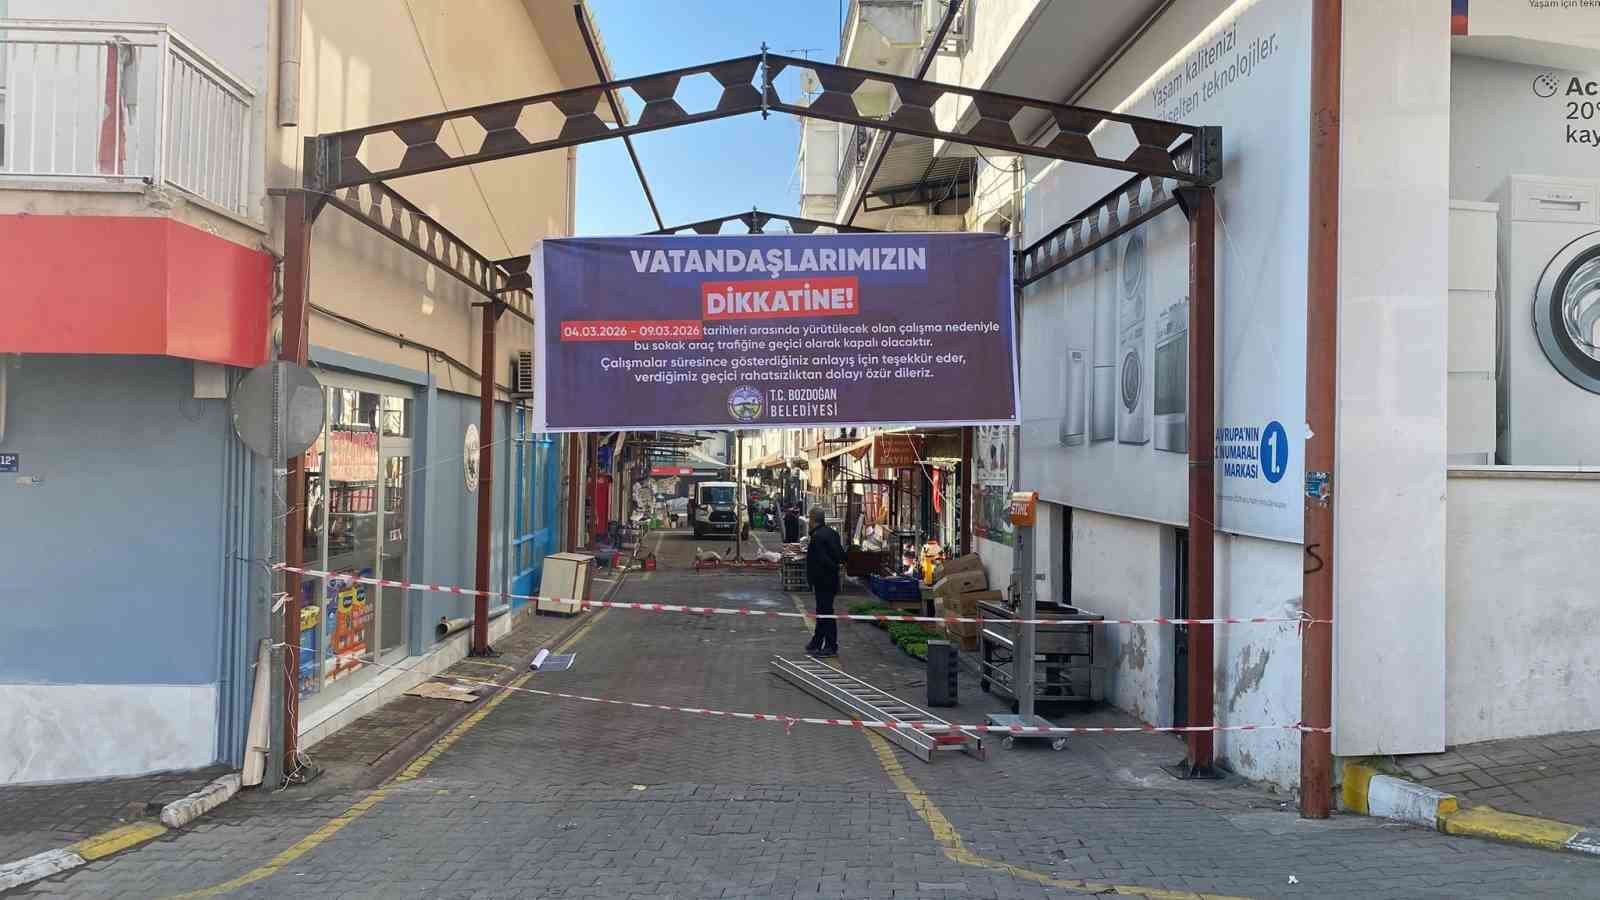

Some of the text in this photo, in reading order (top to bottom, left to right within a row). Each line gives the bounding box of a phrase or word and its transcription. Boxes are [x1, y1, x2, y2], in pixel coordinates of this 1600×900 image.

[1152, 21, 1237, 108] Yaşam kalitenizi
[1202, 33, 1279, 102] teknolojiler.
[630, 248, 926, 278] VATANDAŞLARIMIZIN
[707, 283, 854, 314] DİKKATİNE!
[563, 326, 627, 337] 04.03.2026
[639, 325, 700, 336] 09.03.2026
[703, 325, 747, 335] tarihleri
[750, 324, 799, 335] arasında
[803, 323, 869, 336] yürütülecek
[871, 323, 896, 333] olan
[899, 323, 942, 336] çalışma
[945, 321, 1000, 334] nedeniyle
[634, 336, 933, 353] bu sokak araç trafiğine geçici olarak kapalı olacaktır.
[600, 352, 967, 371] Çalışmalar süresince gösterdiğiniz anlayış için teşekkür eder,
[634, 366, 934, 385] verdiğimiz geçici rahatsızlıktan dolayı özür dileriz.
[770, 387, 837, 401] T.C. BOZDOĞAN
[770, 403, 838, 417] BELEDİYESİ
[1215, 426, 1259, 442] AVRUPA'NIN
[1224, 463, 1259, 479] MARKASI
